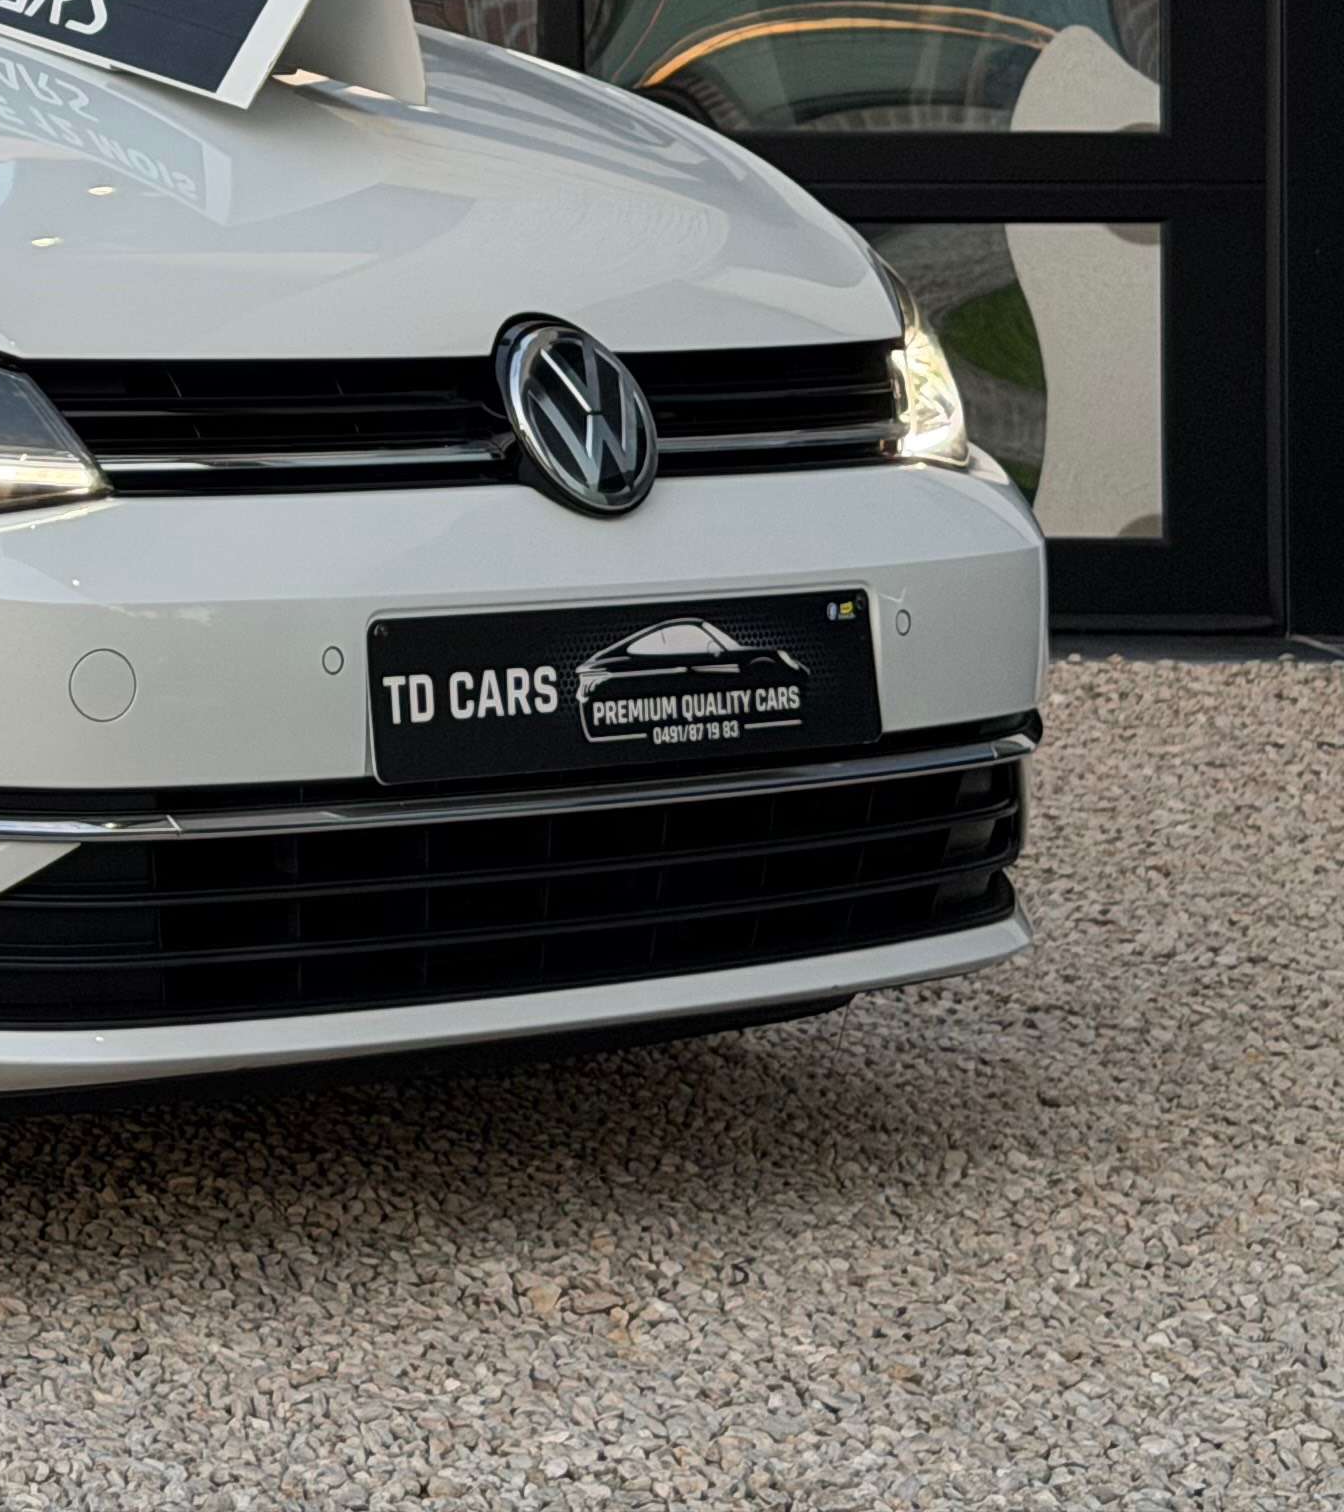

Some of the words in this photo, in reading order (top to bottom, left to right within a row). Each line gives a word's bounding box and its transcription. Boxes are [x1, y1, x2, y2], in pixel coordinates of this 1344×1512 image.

[383, 673, 434, 725] TD
[449, 665, 559, 720] CARS
[592, 695, 678, 726] PREMIUM
[682, 689, 751, 720] QUALITY
[756, 686, 800, 712] CARS
[653, 721, 703, 745] 0491/87
